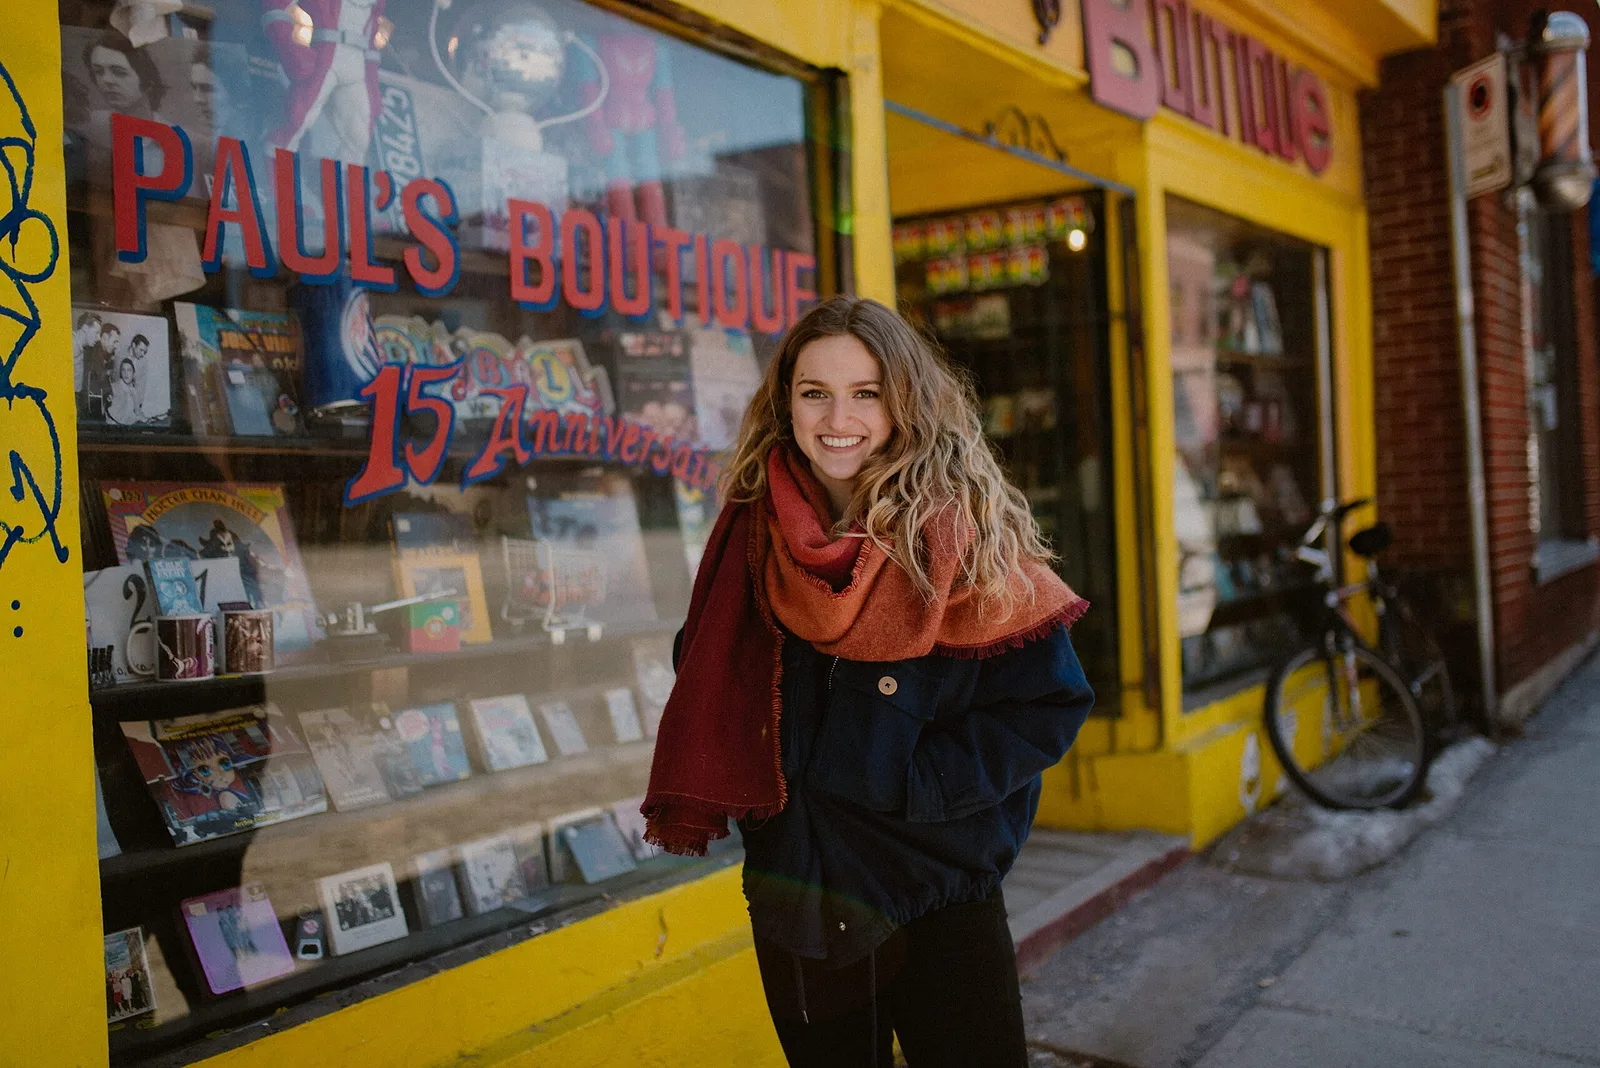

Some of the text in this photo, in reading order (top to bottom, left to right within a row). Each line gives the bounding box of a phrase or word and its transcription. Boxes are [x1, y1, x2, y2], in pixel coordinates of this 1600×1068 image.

[112, 113, 817, 340] PAUL'S BOUTIQUE
[460, 381, 724, 494] Anniversair
